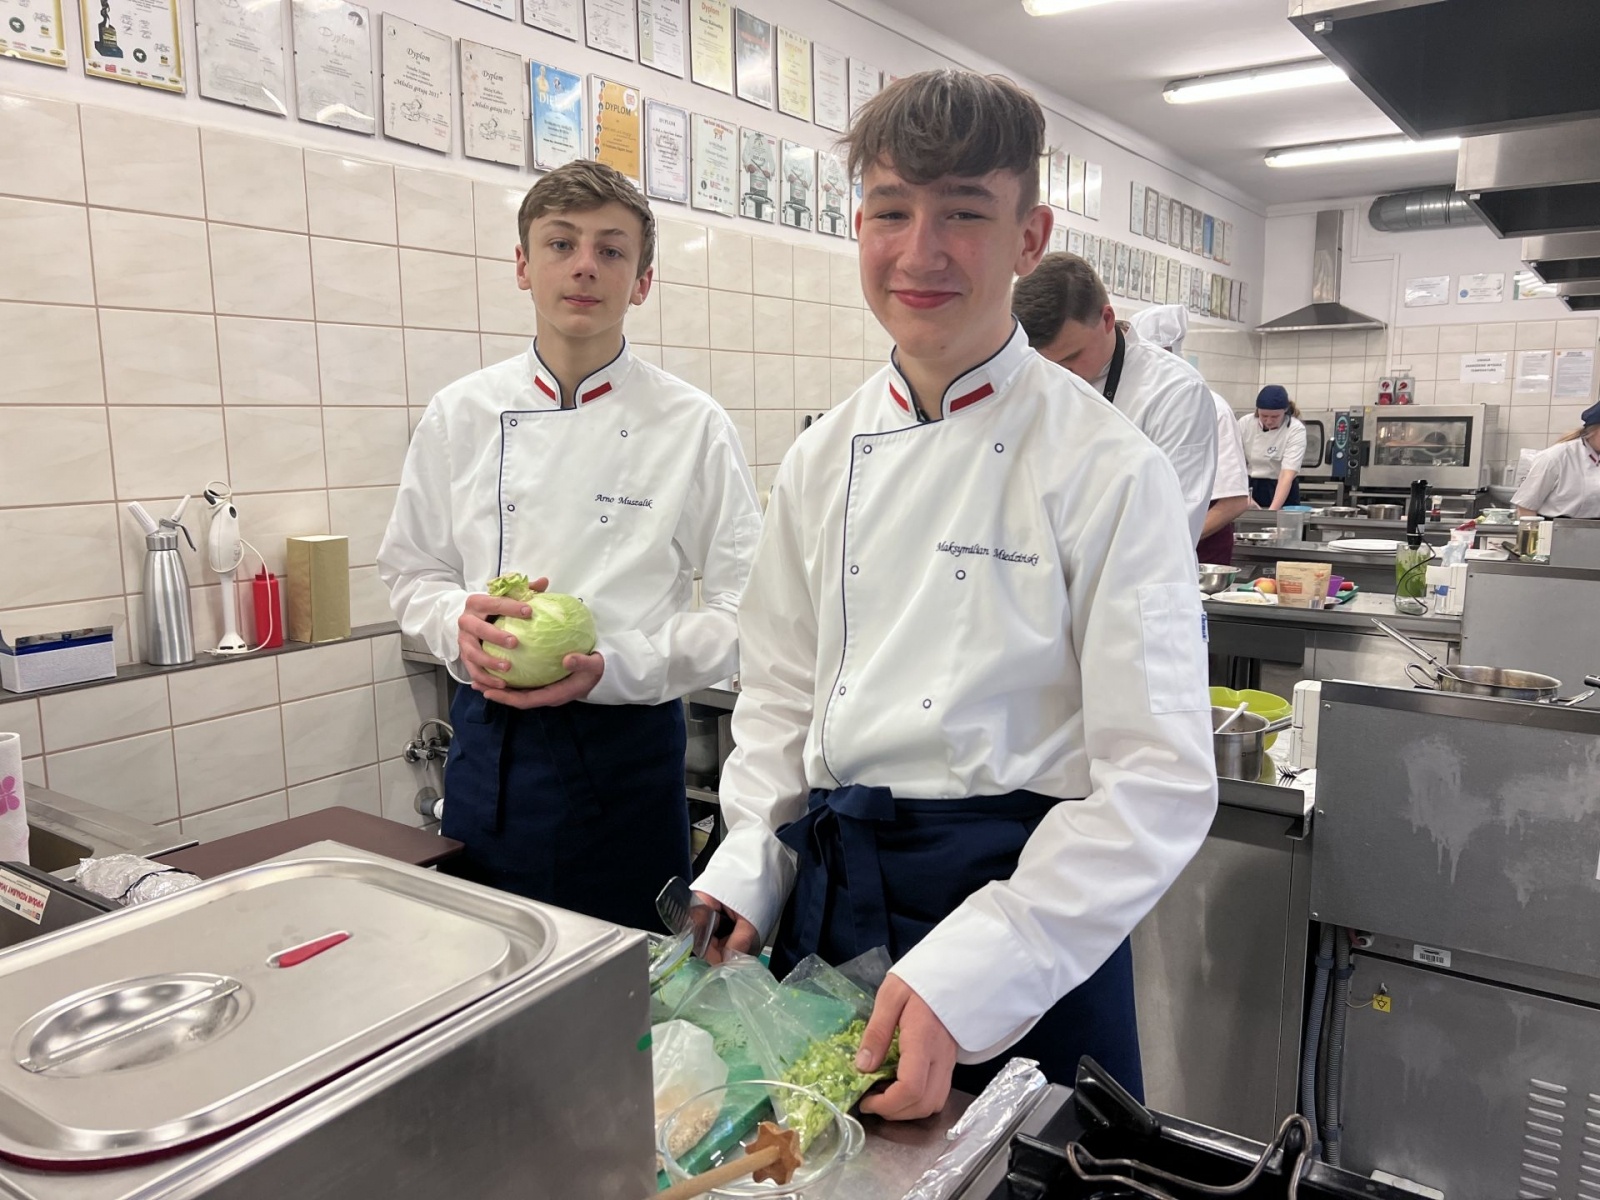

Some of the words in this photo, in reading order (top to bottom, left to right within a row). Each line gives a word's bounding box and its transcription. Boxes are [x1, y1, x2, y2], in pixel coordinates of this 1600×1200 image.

[407, 48, 431, 63] Dyplom
[482, 70, 504, 82] Dyplom
[604, 101, 632, 117] DYPLOM
[594, 493, 615, 503] Arno
[935, 540, 990, 558] Maksymilian
